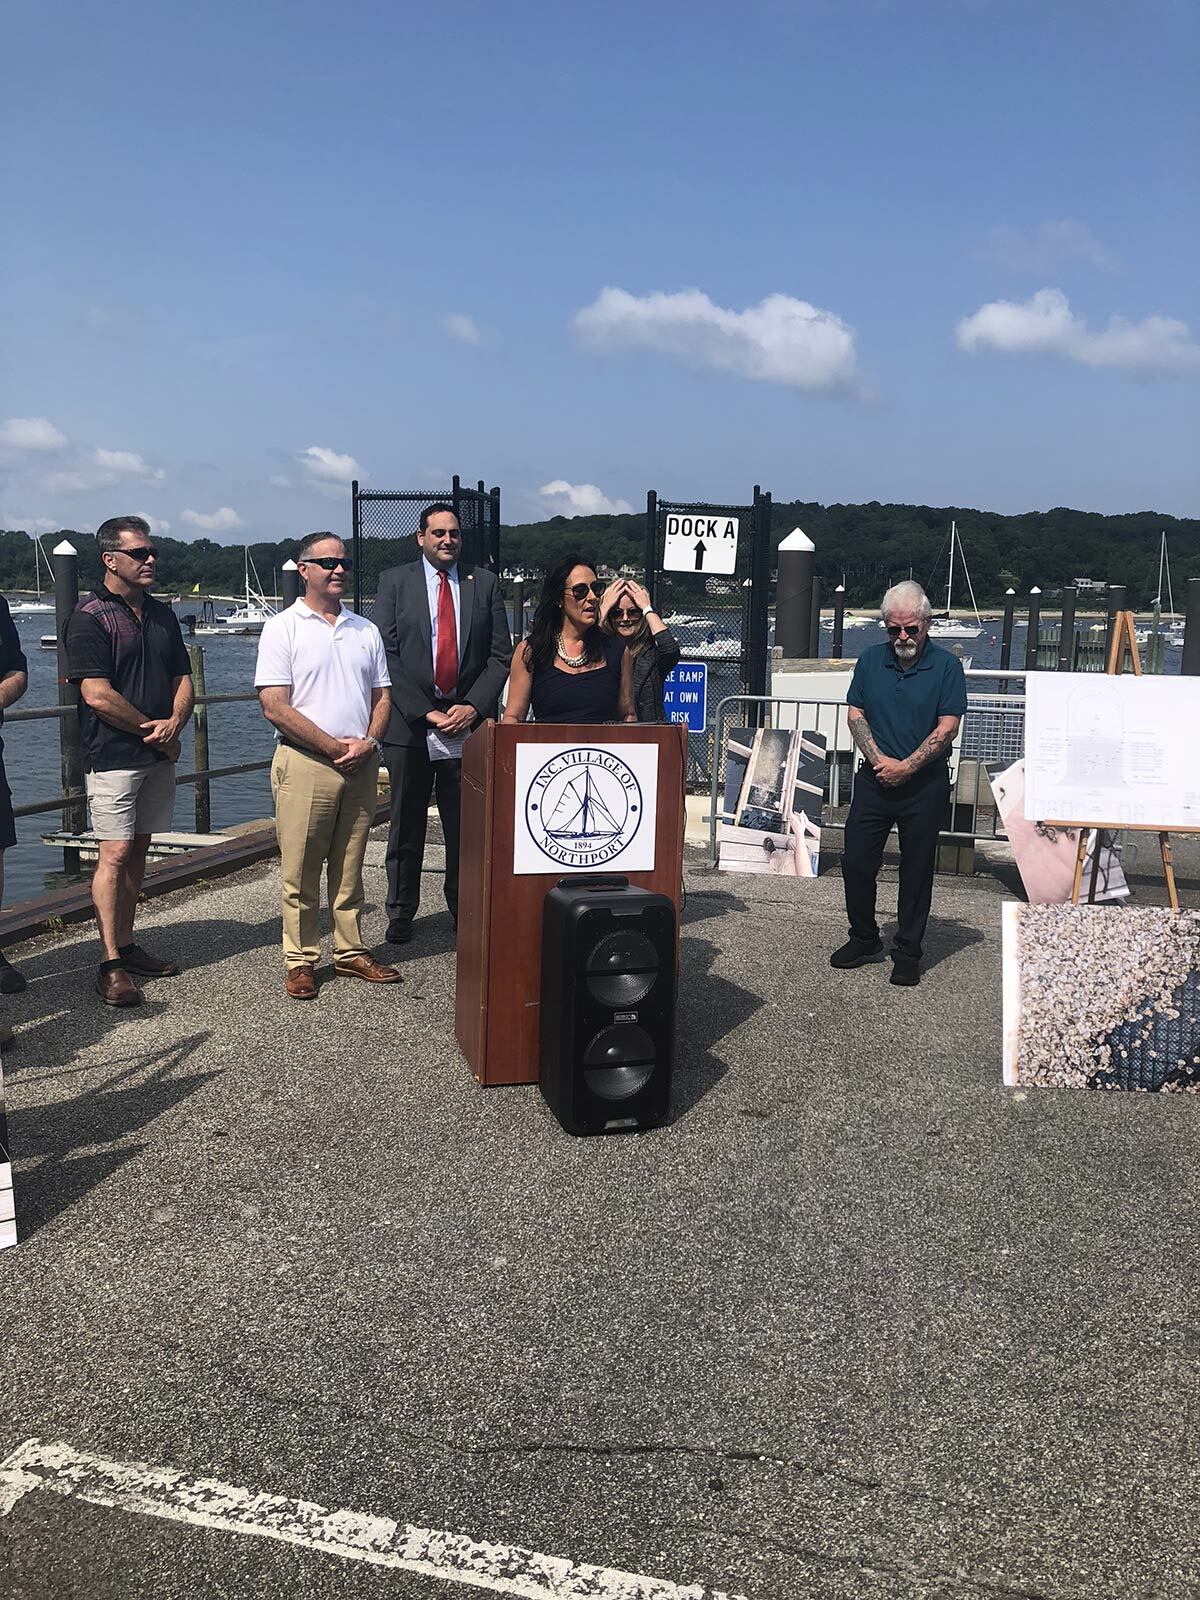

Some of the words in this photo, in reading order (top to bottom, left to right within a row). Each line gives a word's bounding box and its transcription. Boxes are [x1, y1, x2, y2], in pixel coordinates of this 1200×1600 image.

[668, 517, 718, 538] DOCK
[723, 521, 735, 539] A
[665, 671, 675, 682] SE
[679, 671, 704, 683] RAMP
[664, 691, 674, 703] AT
[679, 692, 698, 704] OWN
[671, 711, 690, 723] RISK
[535, 763, 562, 789] INC.
[561, 752, 624, 775] VILLAGE
[621, 773, 637, 792] OF
[540, 836, 626, 864] NORTHPORT
[574, 841, 592, 849] 1894
